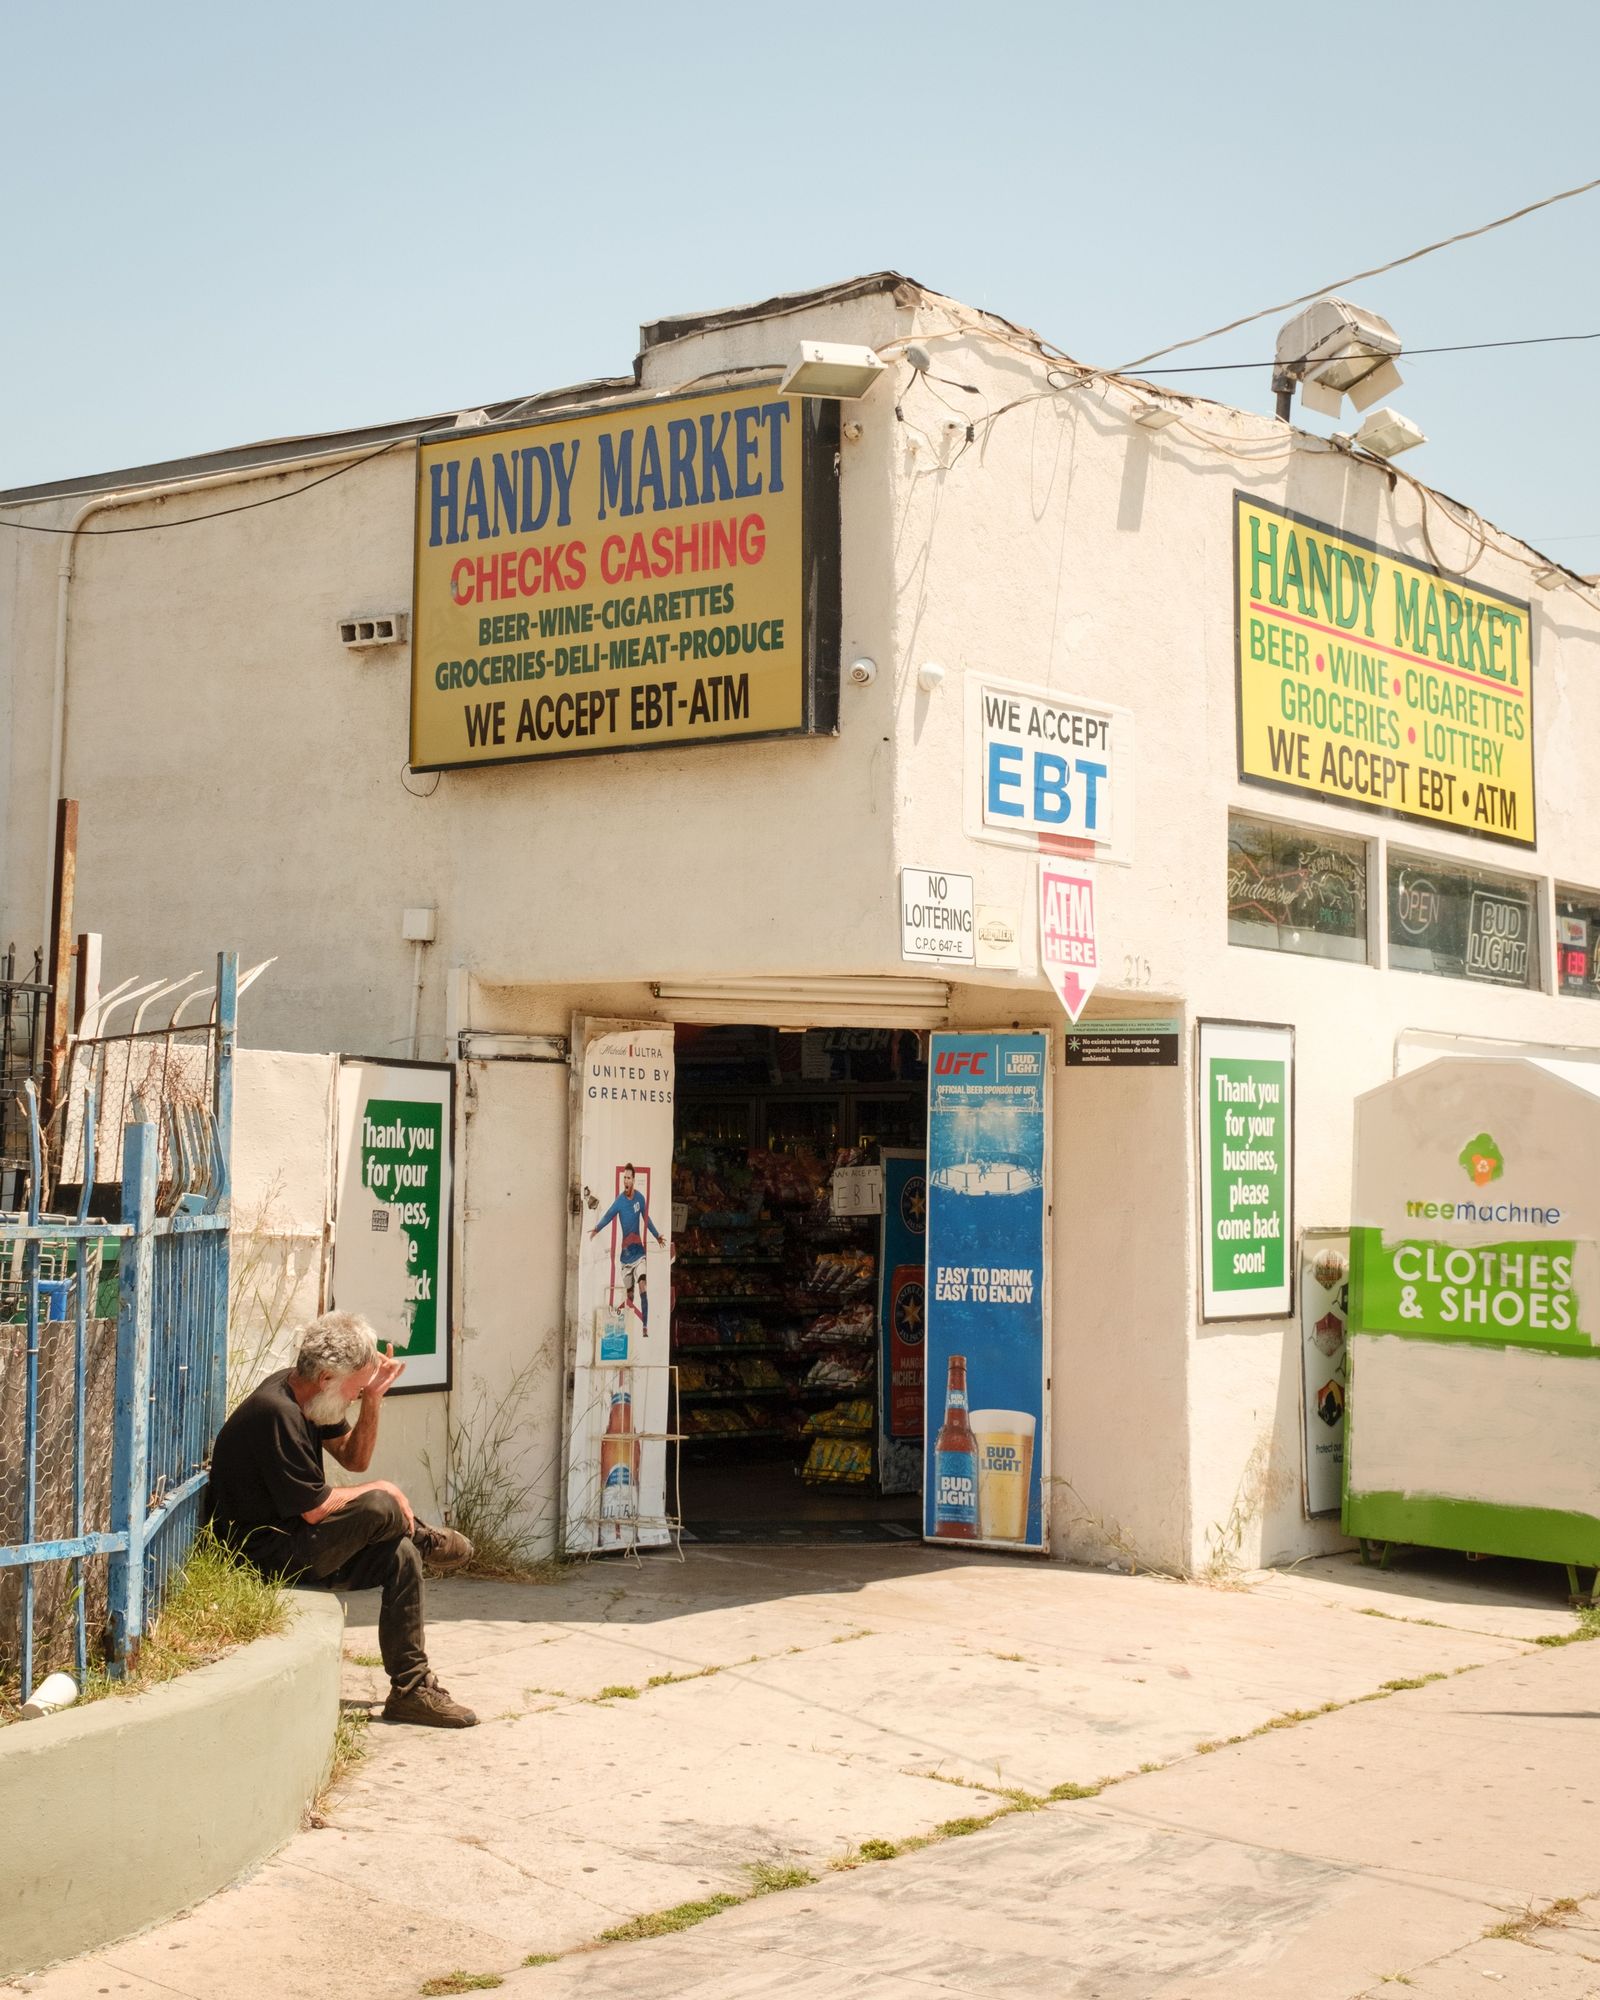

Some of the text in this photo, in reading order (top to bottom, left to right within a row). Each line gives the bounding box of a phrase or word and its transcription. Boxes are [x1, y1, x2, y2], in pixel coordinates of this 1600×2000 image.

[429, 401, 790, 547] HANDY MARKET
[450, 513, 766, 606] CHECKS CASHING
[479, 583, 734, 646] BEER-WINE-CIGARETTES
[1249, 515, 1523, 686] HANDY MARKET
[435, 619, 784, 691] GROCERIES-DELI-MEAT-PRODUCE
[1250, 618, 1524, 741] BEER WINE CIGARETTES
[464, 673, 749, 747] WE ACCEPT EBT-ATM
[985, 695, 1109, 751] WE ACCEPT
[1281, 678, 1504, 778] GROCERIES LOTTERY
[988, 741, 1107, 830] EBT
[1267, 725, 1517, 831] WE ACCEPT EBT ATM
[928, 875, 948, 900] NO
[1228, 868, 1299, 904] Budweiser
[905, 903, 972, 933] LOITERING
[1044, 879, 1094, 940] ATM
[1399, 889, 1440, 923] OPEN
[1481, 901, 1520, 939] BUD
[938, 939, 963, 953] 647-E
[1046, 936, 1094, 964] HERE
[1469, 933, 1527, 975] LIGHT
[634, 1047, 663, 1059] ULTRA
[934, 1052, 988, 1075] UFC
[1007, 1063, 1039, 1074] LIGHT
[1011, 1054, 1035, 1064] BUD
[592, 1064, 669, 1082] UNITED BY
[588, 1086, 672, 1104] GREATNESS
[937, 1085, 1036, 1095] OFFICIAL BEER SPONSOR OF UFC
[1215, 1074, 1280, 1110] Thank you
[1224, 1108, 1275, 1144] for your
[408, 1126, 435, 1158] you
[851, 1168, 879, 1177] ACCEPT
[1223, 1142, 1278, 1175] business,
[366, 1155, 428, 1196] for your
[633, 1201, 640, 1213] 10
[1229, 1177, 1269, 1213] please
[1217, 1210, 1280, 1241] come back
[1406, 1199, 1561, 1225] treemachine
[1233, 1245, 1265, 1274] soon!
[1393, 1246, 1571, 1292] CLOTHES
[937, 1267, 1033, 1286] EASY TO DRINK
[935, 1283, 1034, 1304] EASY TO ENJOY
[1398, 1285, 1571, 1331] & SHOES
[948, 1398, 966, 1406] LIGHT
[950, 1393, 964, 1401] BUD
[981, 1458, 1022, 1472] LIGHT
[986, 1446, 1016, 1459] BUD
[937, 1490, 976, 1507] LIGHT
[941, 1476, 972, 1491] BUD
